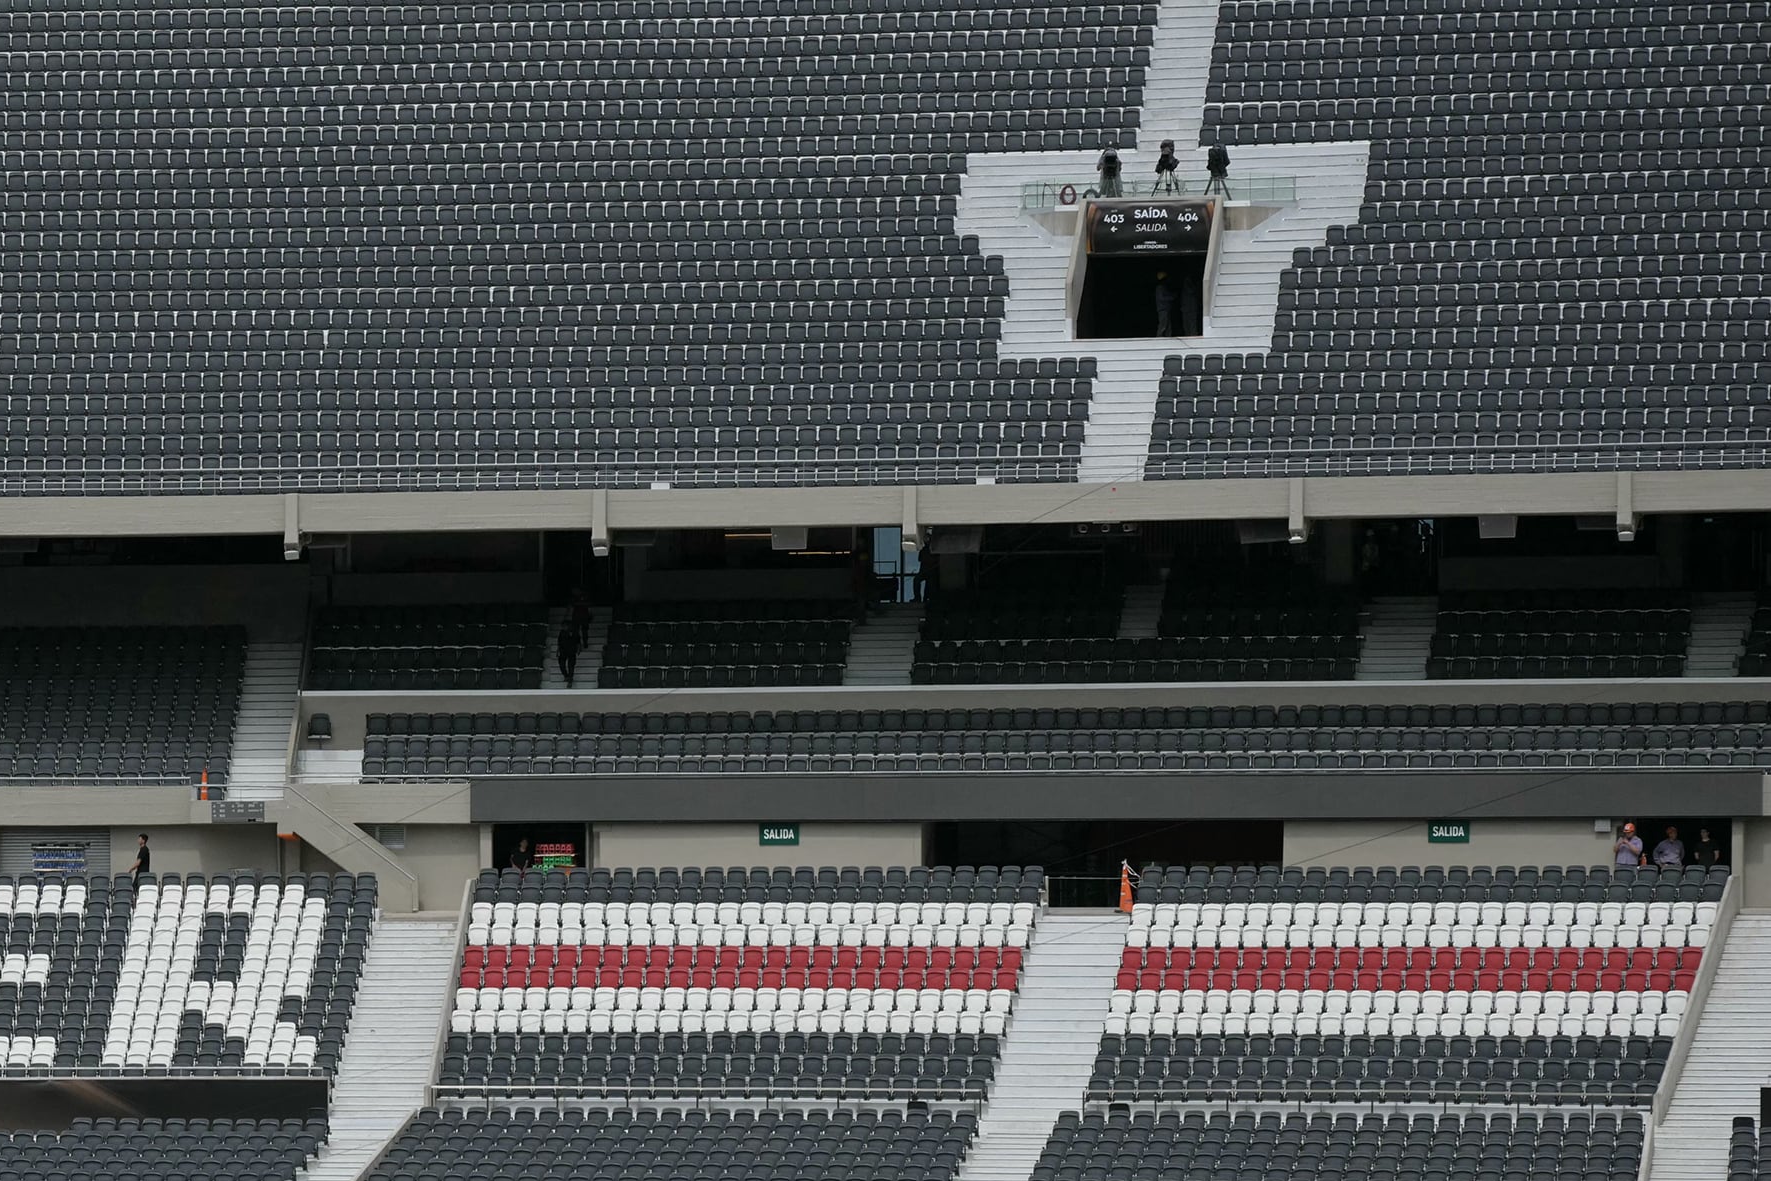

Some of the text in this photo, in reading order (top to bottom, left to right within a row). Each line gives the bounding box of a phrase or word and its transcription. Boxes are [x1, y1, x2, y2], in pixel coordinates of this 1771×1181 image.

[1134, 206, 1168, 219] SAÍDA
[1177, 213, 1199, 222] 404
[1103, 214, 1124, 223] 403
[1135, 223, 1167, 232] SALIDA
[763, 829, 795, 840] SALIDA
[1432, 826, 1465, 837] SALIDA
